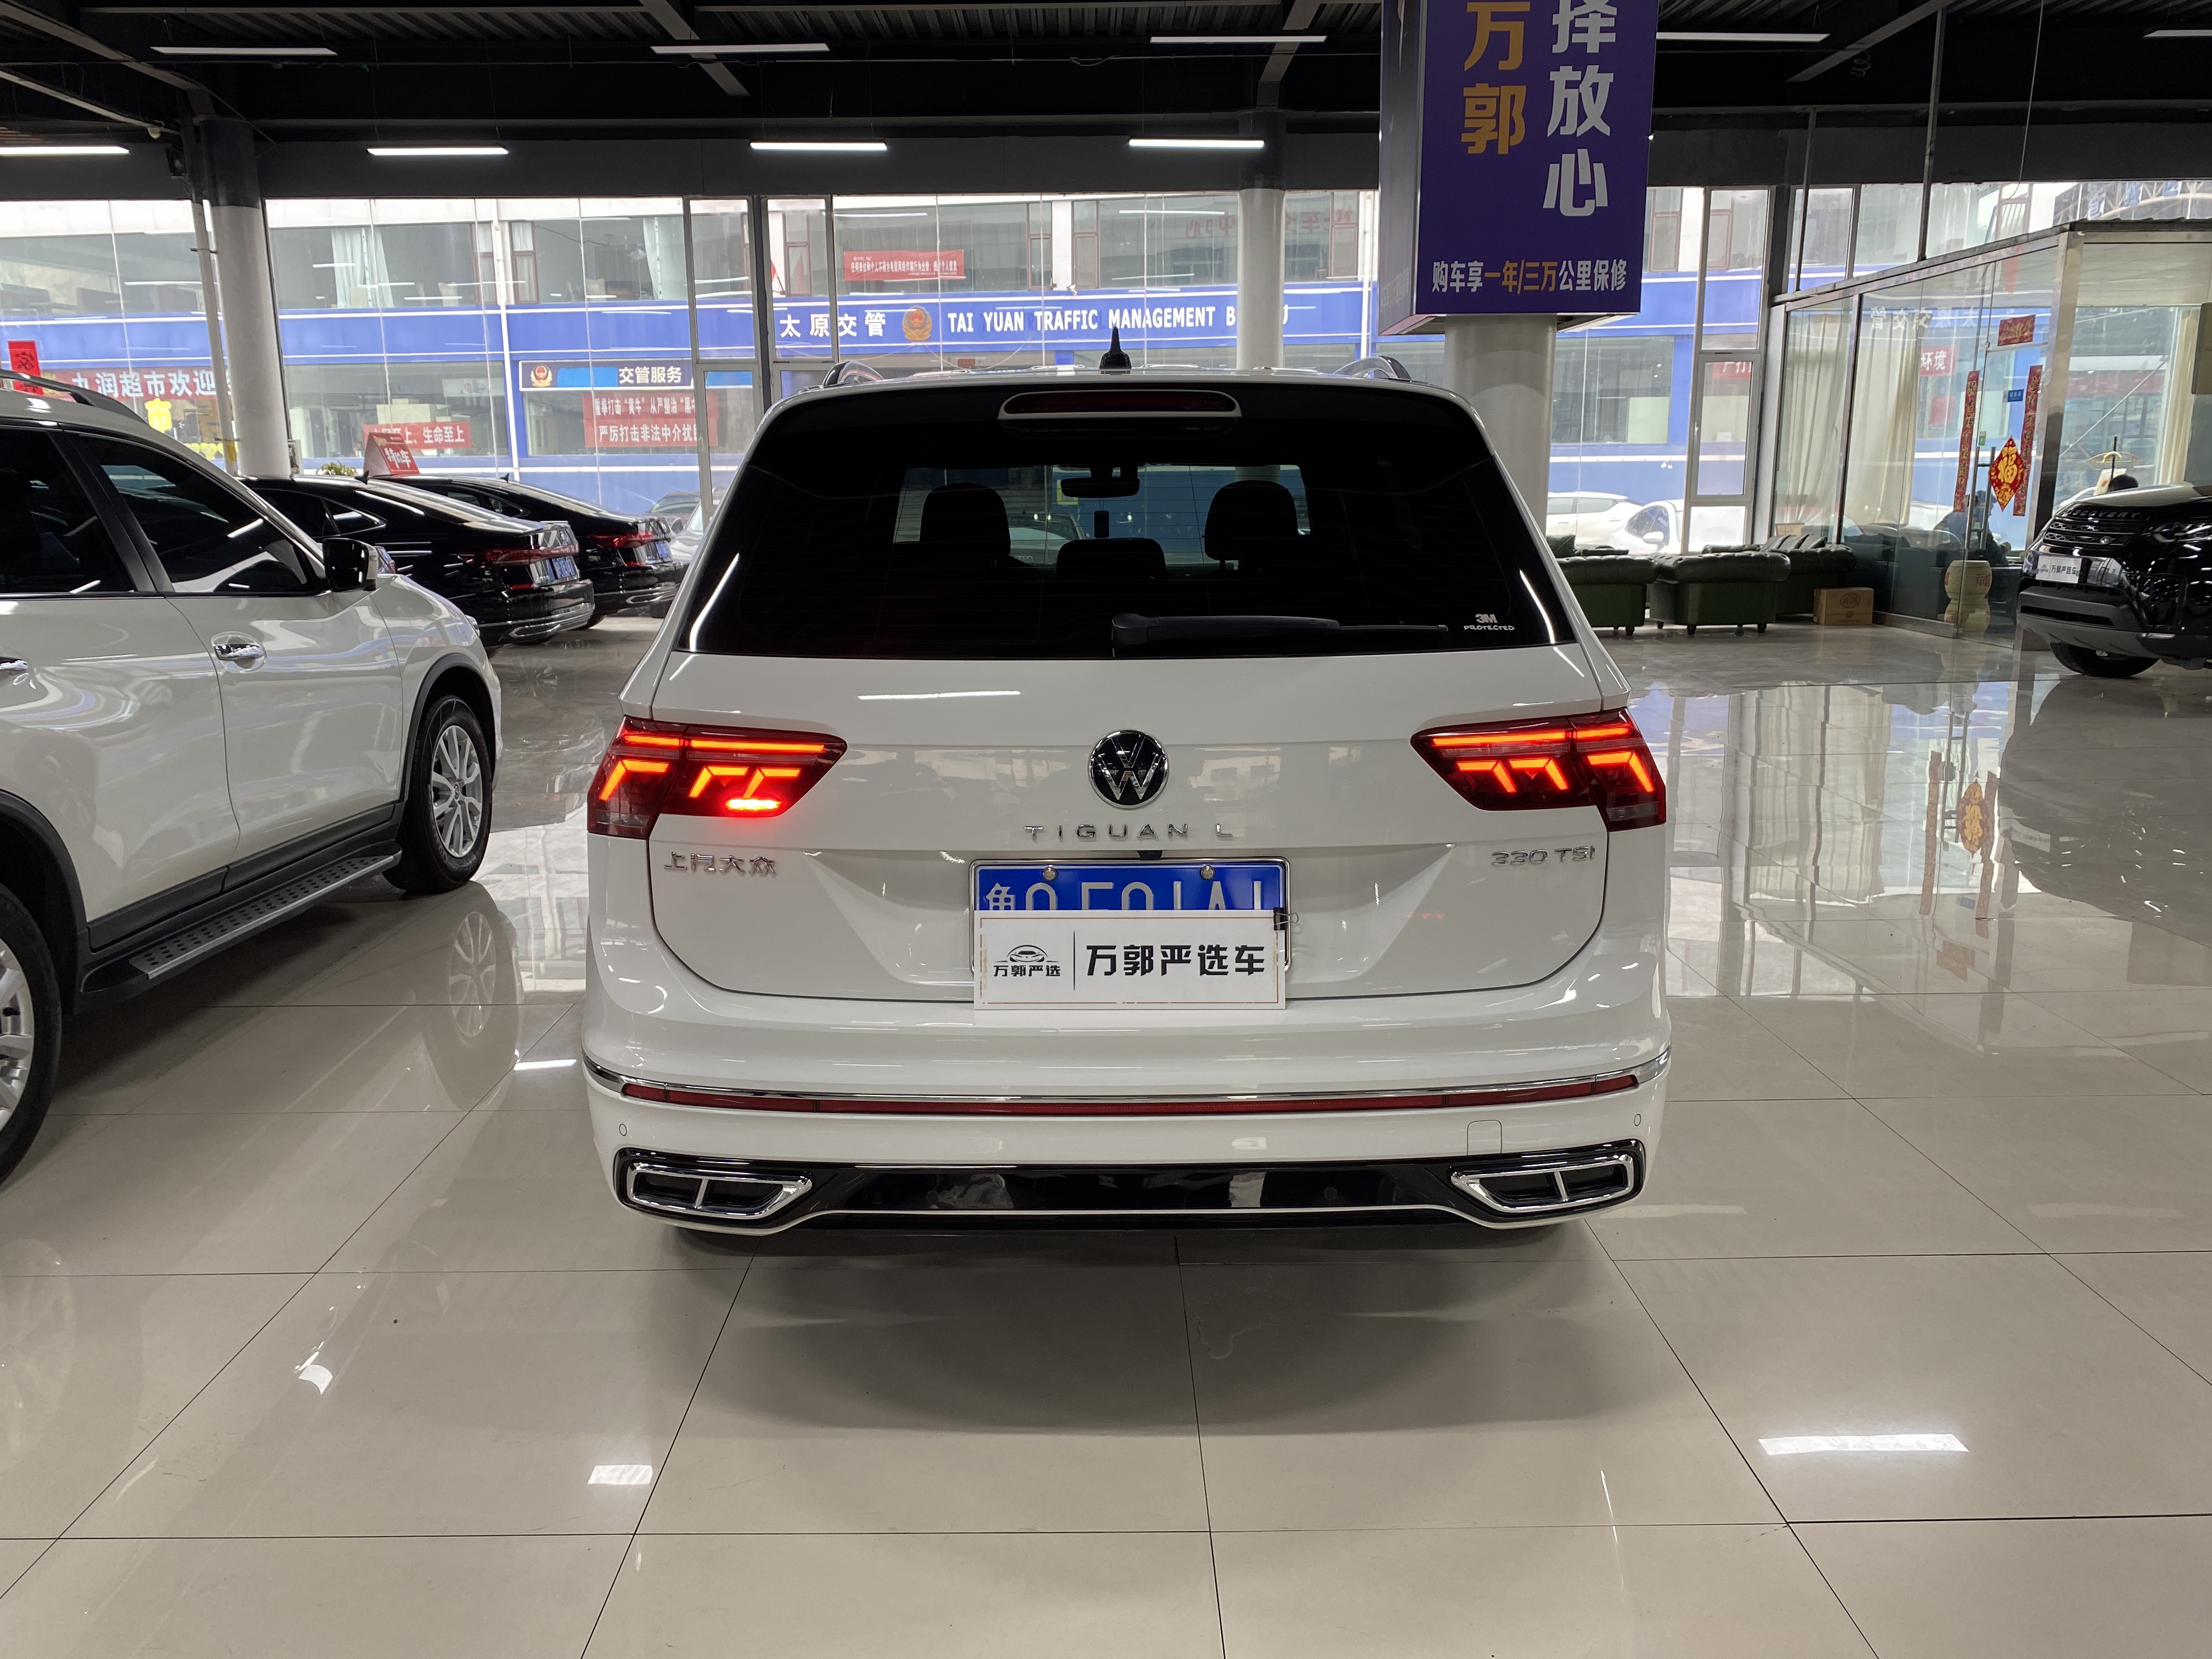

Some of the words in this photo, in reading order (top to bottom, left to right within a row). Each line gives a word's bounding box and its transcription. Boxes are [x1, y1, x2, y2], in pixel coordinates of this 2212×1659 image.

[1460, 2, 1531, 155] 万郭
[1542, 0, 1618, 217] 择放心
[1431, 259, 1627, 294] 购车享一年/三万公里保修
[779, 312, 886, 338] 太原交管
[947, 313, 974, 332] TAI
[984, 312, 1024, 332] YUAN
[1034, 309, 1098, 331] TRAFFIC
[1108, 306, 1216, 329] MANAGEMENT
[72, 369, 232, 397] 九润超市欢迎
[618, 366, 682, 383] 交管服务
[1475, 613, 1498, 624] 3M
[1024, 823, 1189, 840] TIGUAN
[1215, 823, 1234, 838] L
[663, 851, 776, 877] 上汽大众
[1491, 849, 1548, 867] 330
[1554, 845, 1595, 863] TSI
[993, 964, 1061, 977] 万郭严选
[1086, 944, 1265, 977] 万郭严选车
